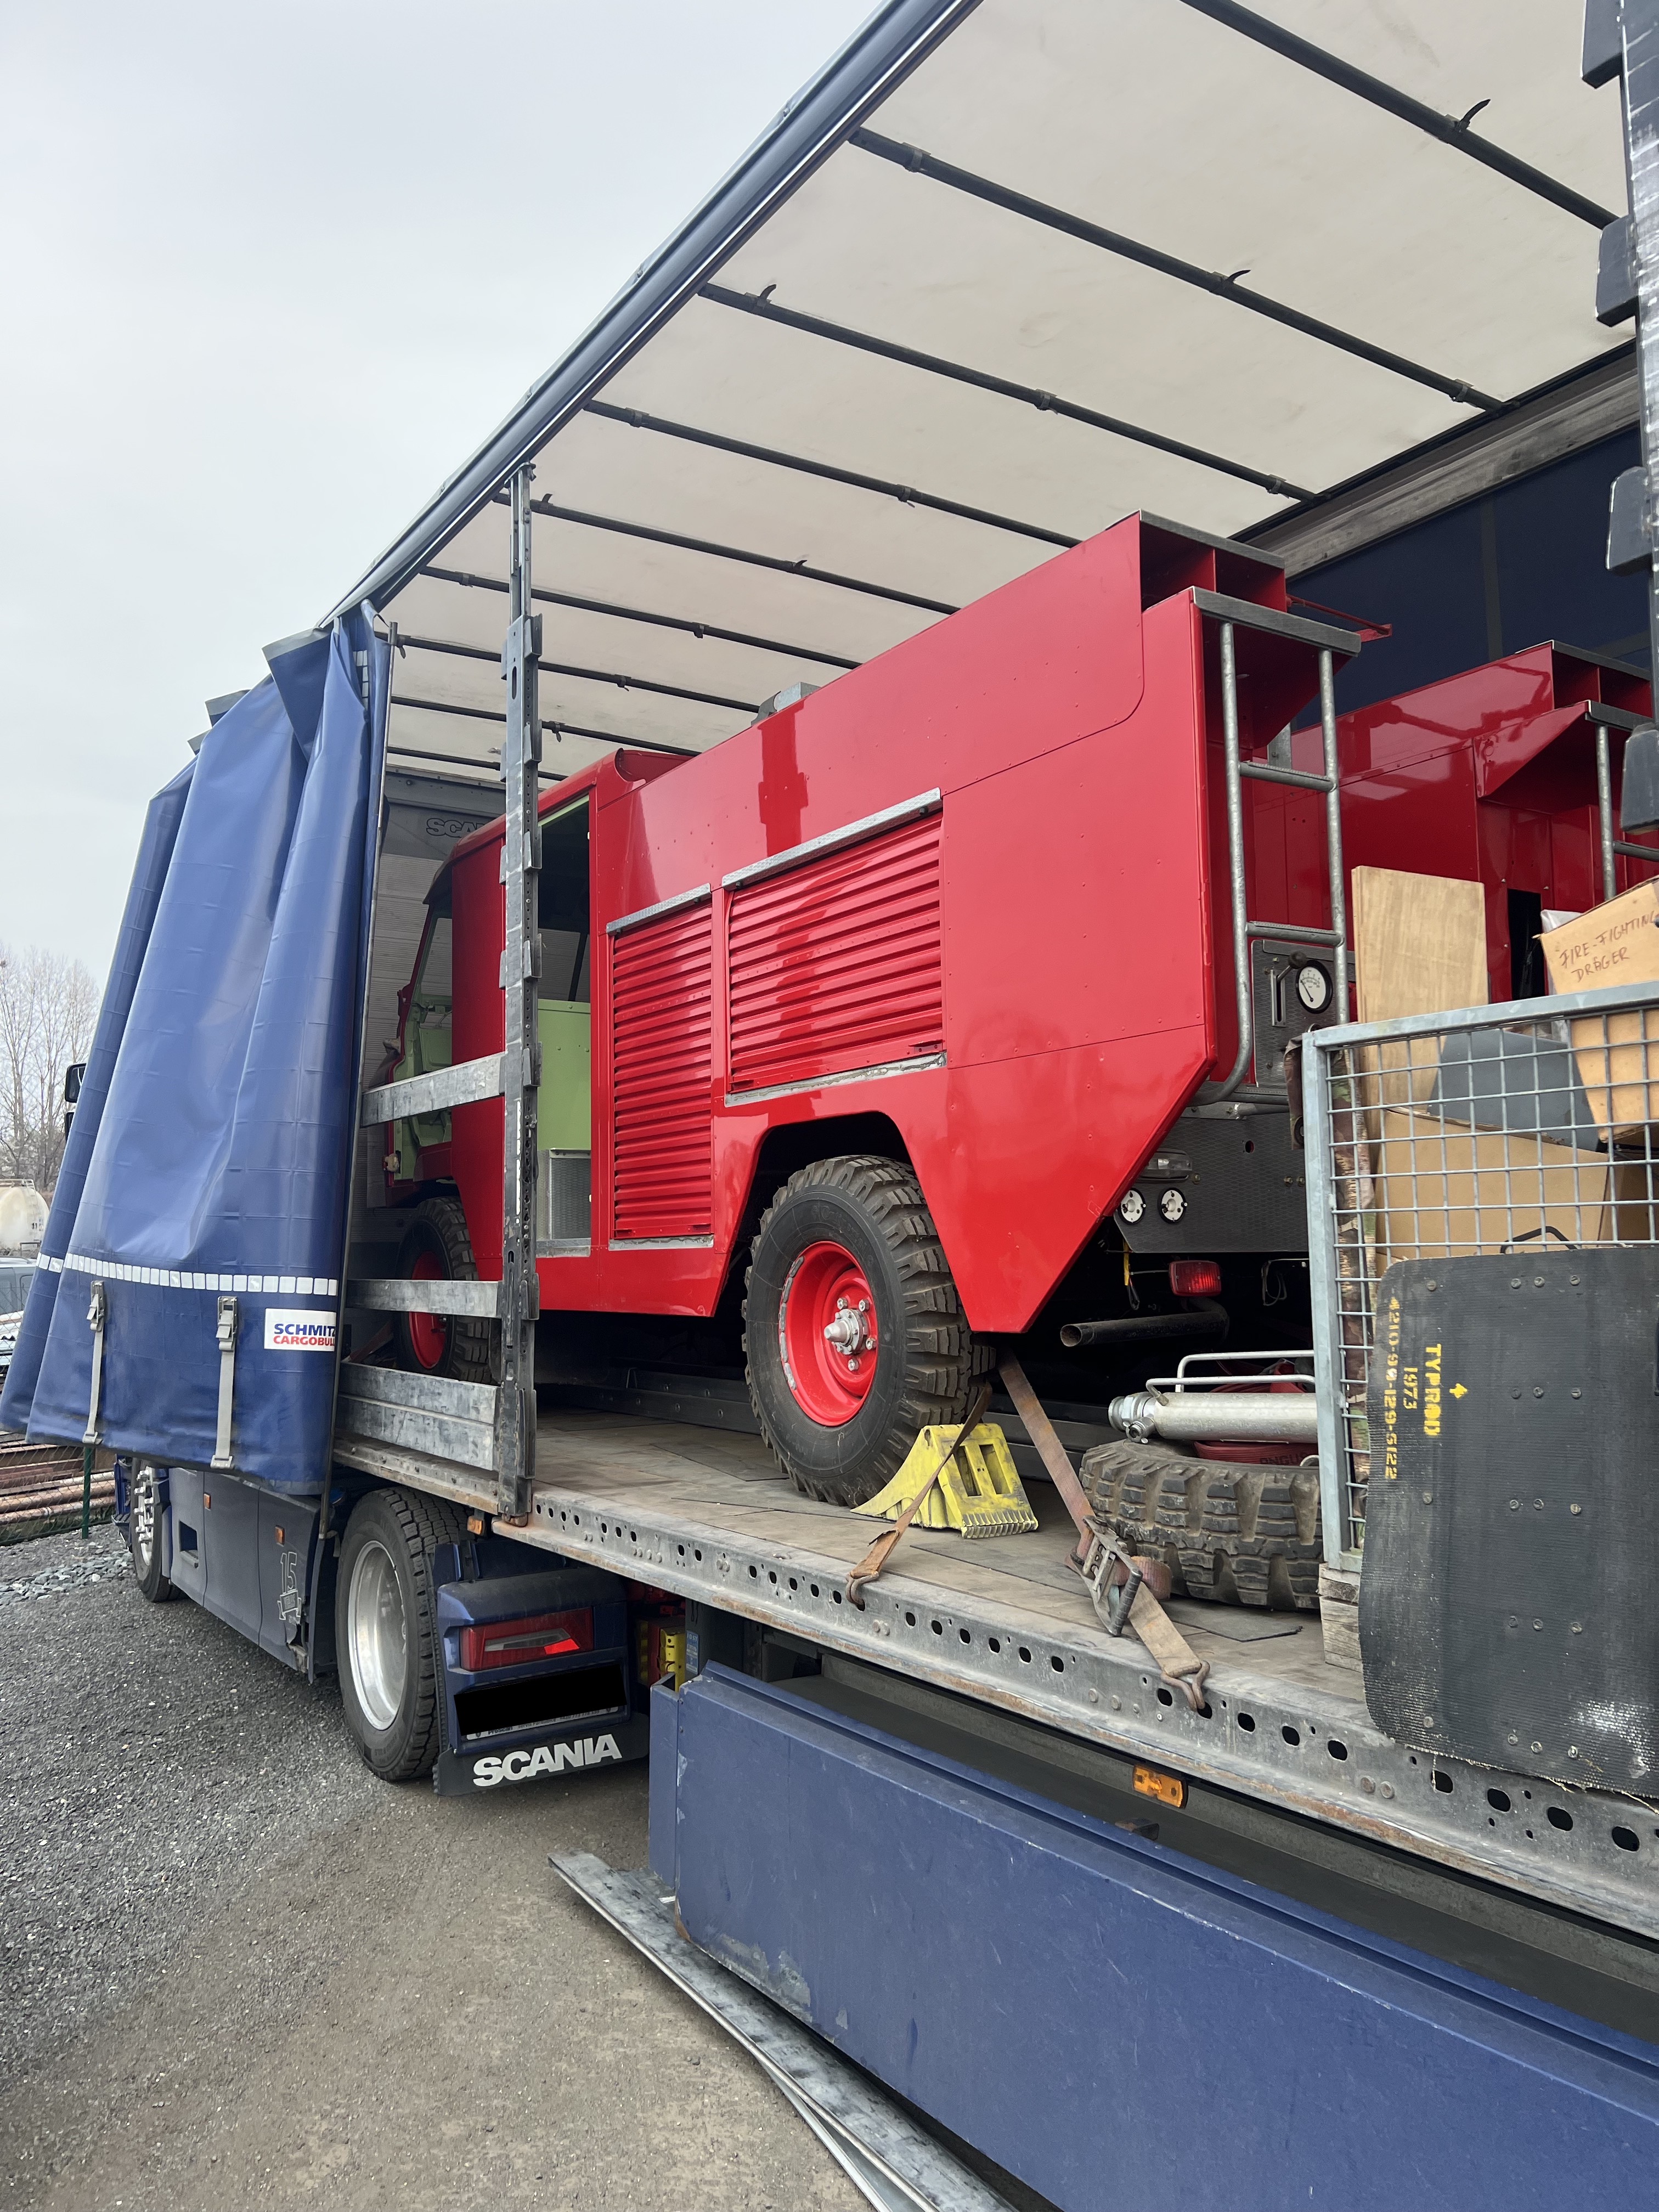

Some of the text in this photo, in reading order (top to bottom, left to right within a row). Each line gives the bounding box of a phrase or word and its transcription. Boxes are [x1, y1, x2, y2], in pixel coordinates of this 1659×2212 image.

[1403, 1367, 1418, 1410] 1973
[280, 1551, 297, 1595] 15
[473, 1734, 622, 1787] SCANIA
